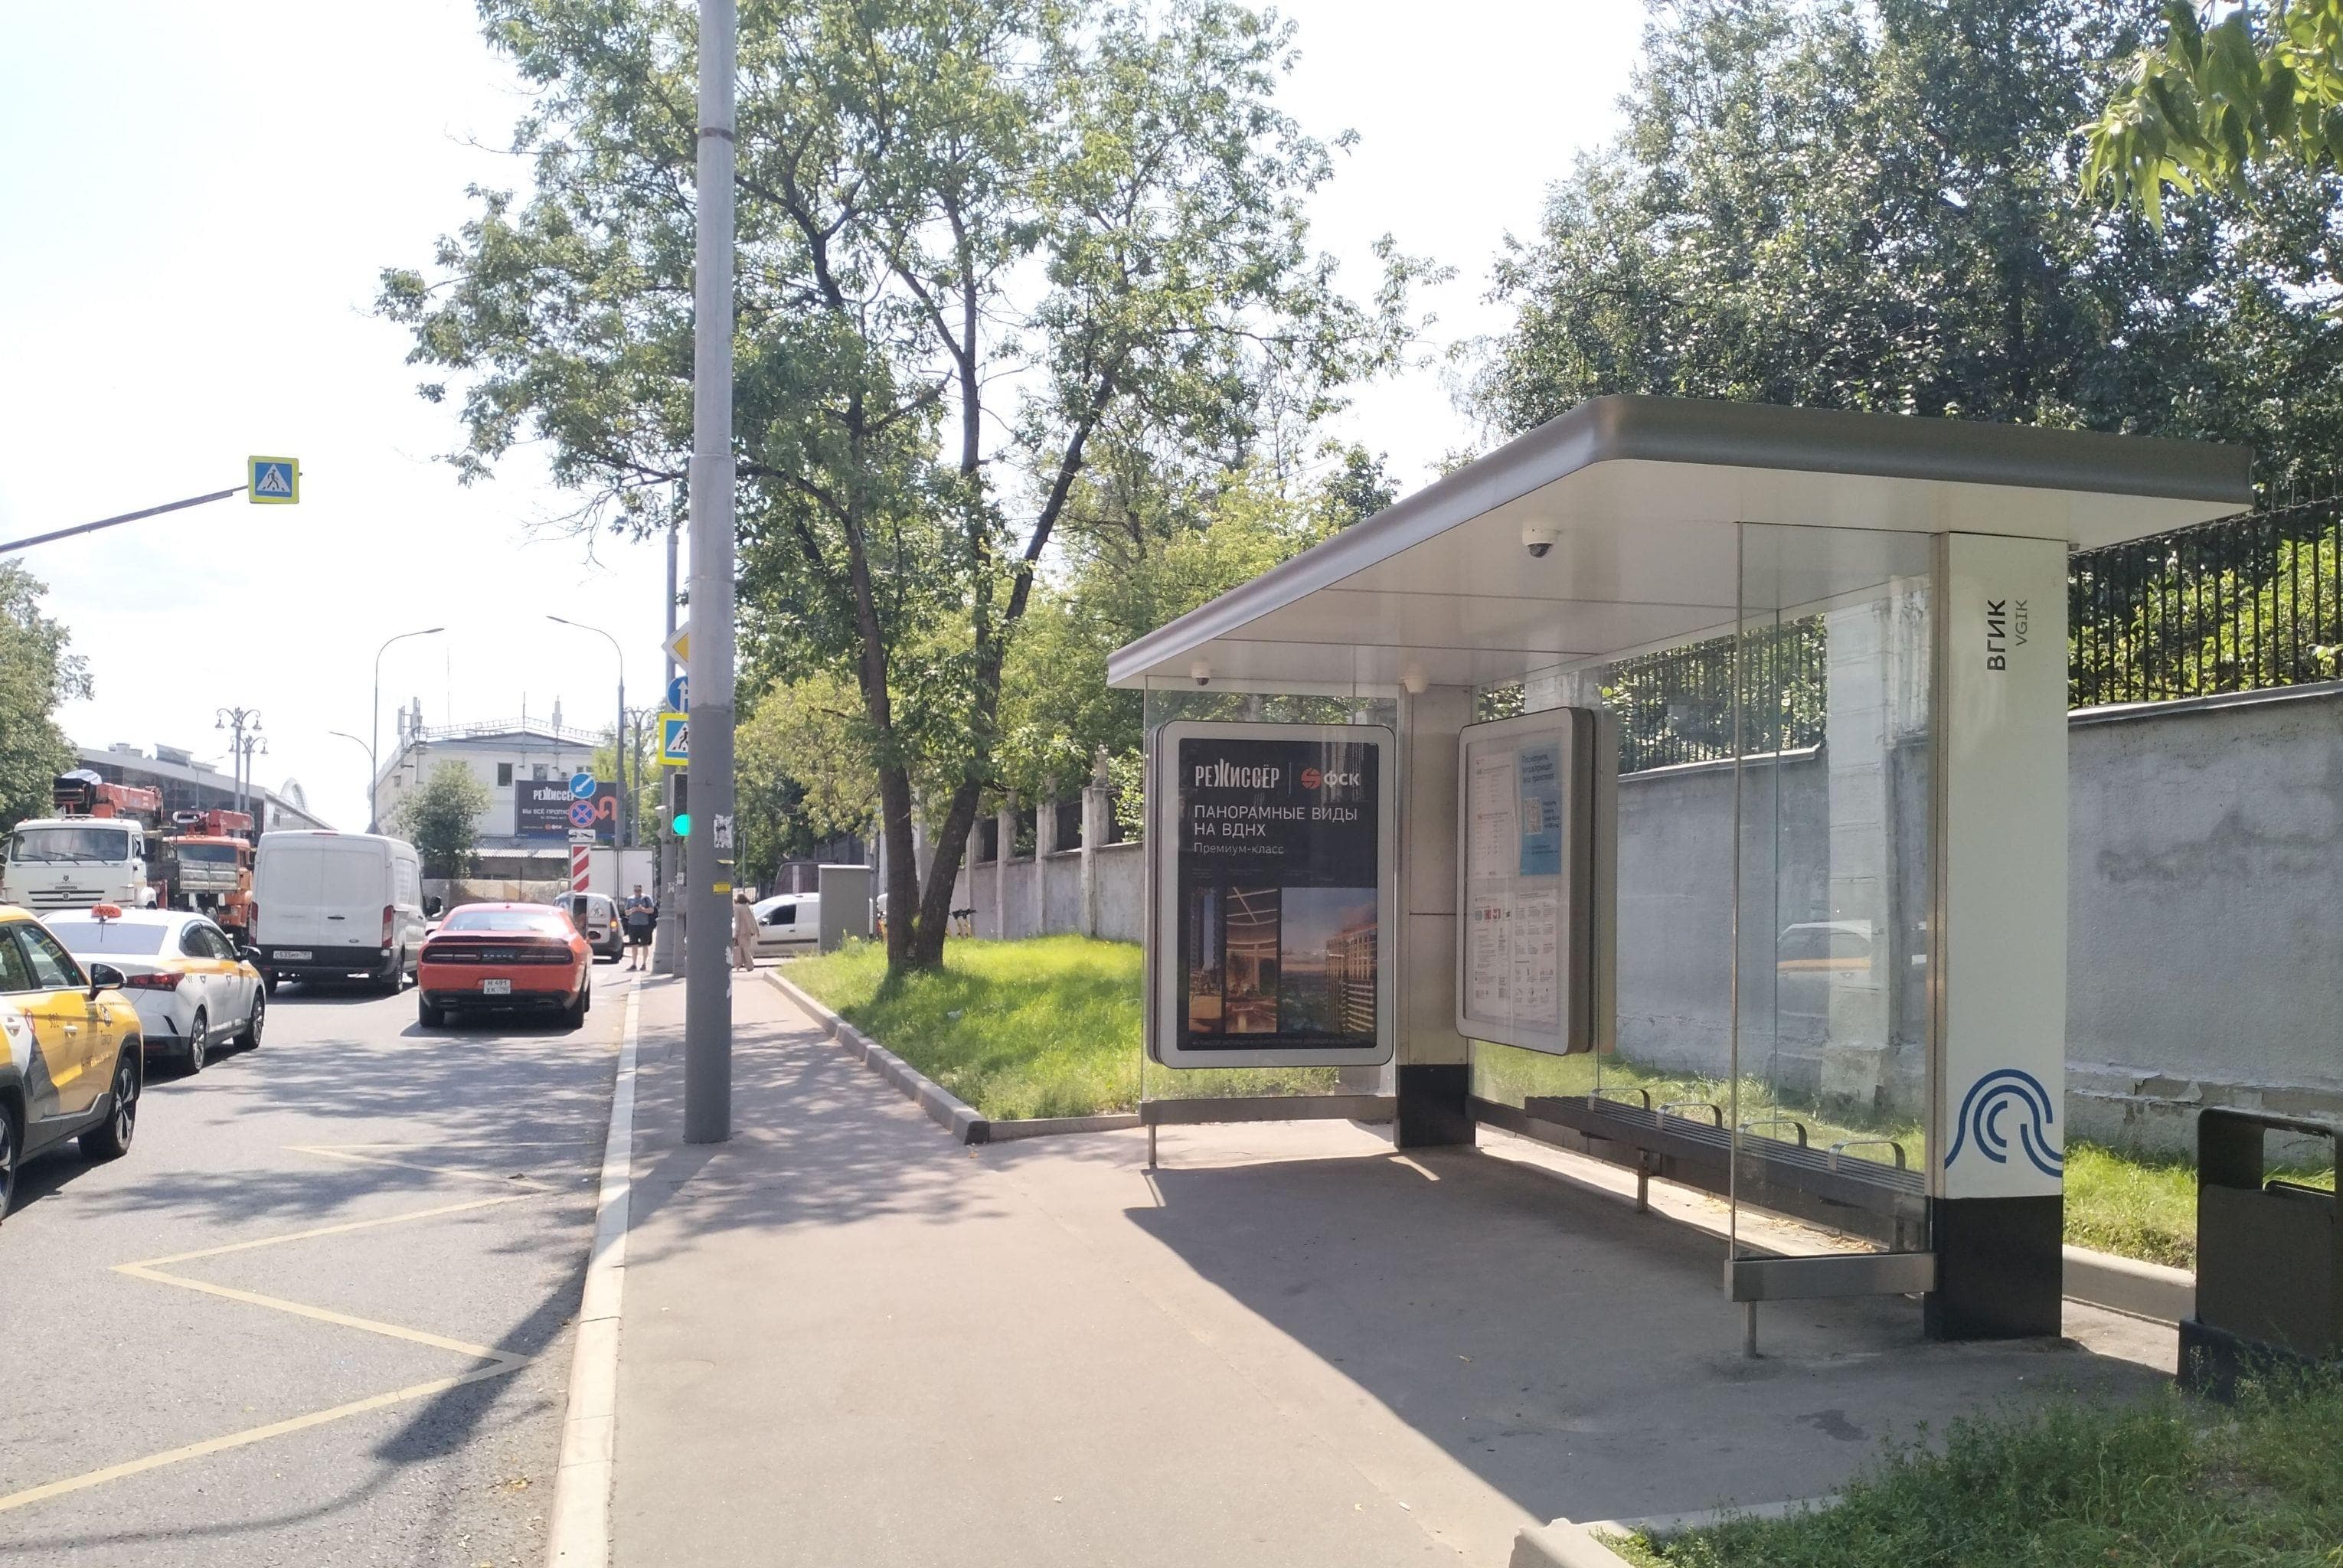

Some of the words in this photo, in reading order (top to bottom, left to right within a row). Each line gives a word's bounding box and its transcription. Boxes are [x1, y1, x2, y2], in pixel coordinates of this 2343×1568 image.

[2015, 599, 2028, 646] VGIK
[1987, 599, 2005, 671] ВГИК
[1195, 758, 1279, 789] РЕЖИССЁР
[1194, 805, 1305, 820] ПАНОРАМНЫЕ
[1312, 806, 1358, 823] ВИДЫ
[1194, 822, 1216, 836] НА
[1222, 823, 1266, 838] ВДНХ
[1194, 842, 1284, 856] Премиум-класс
